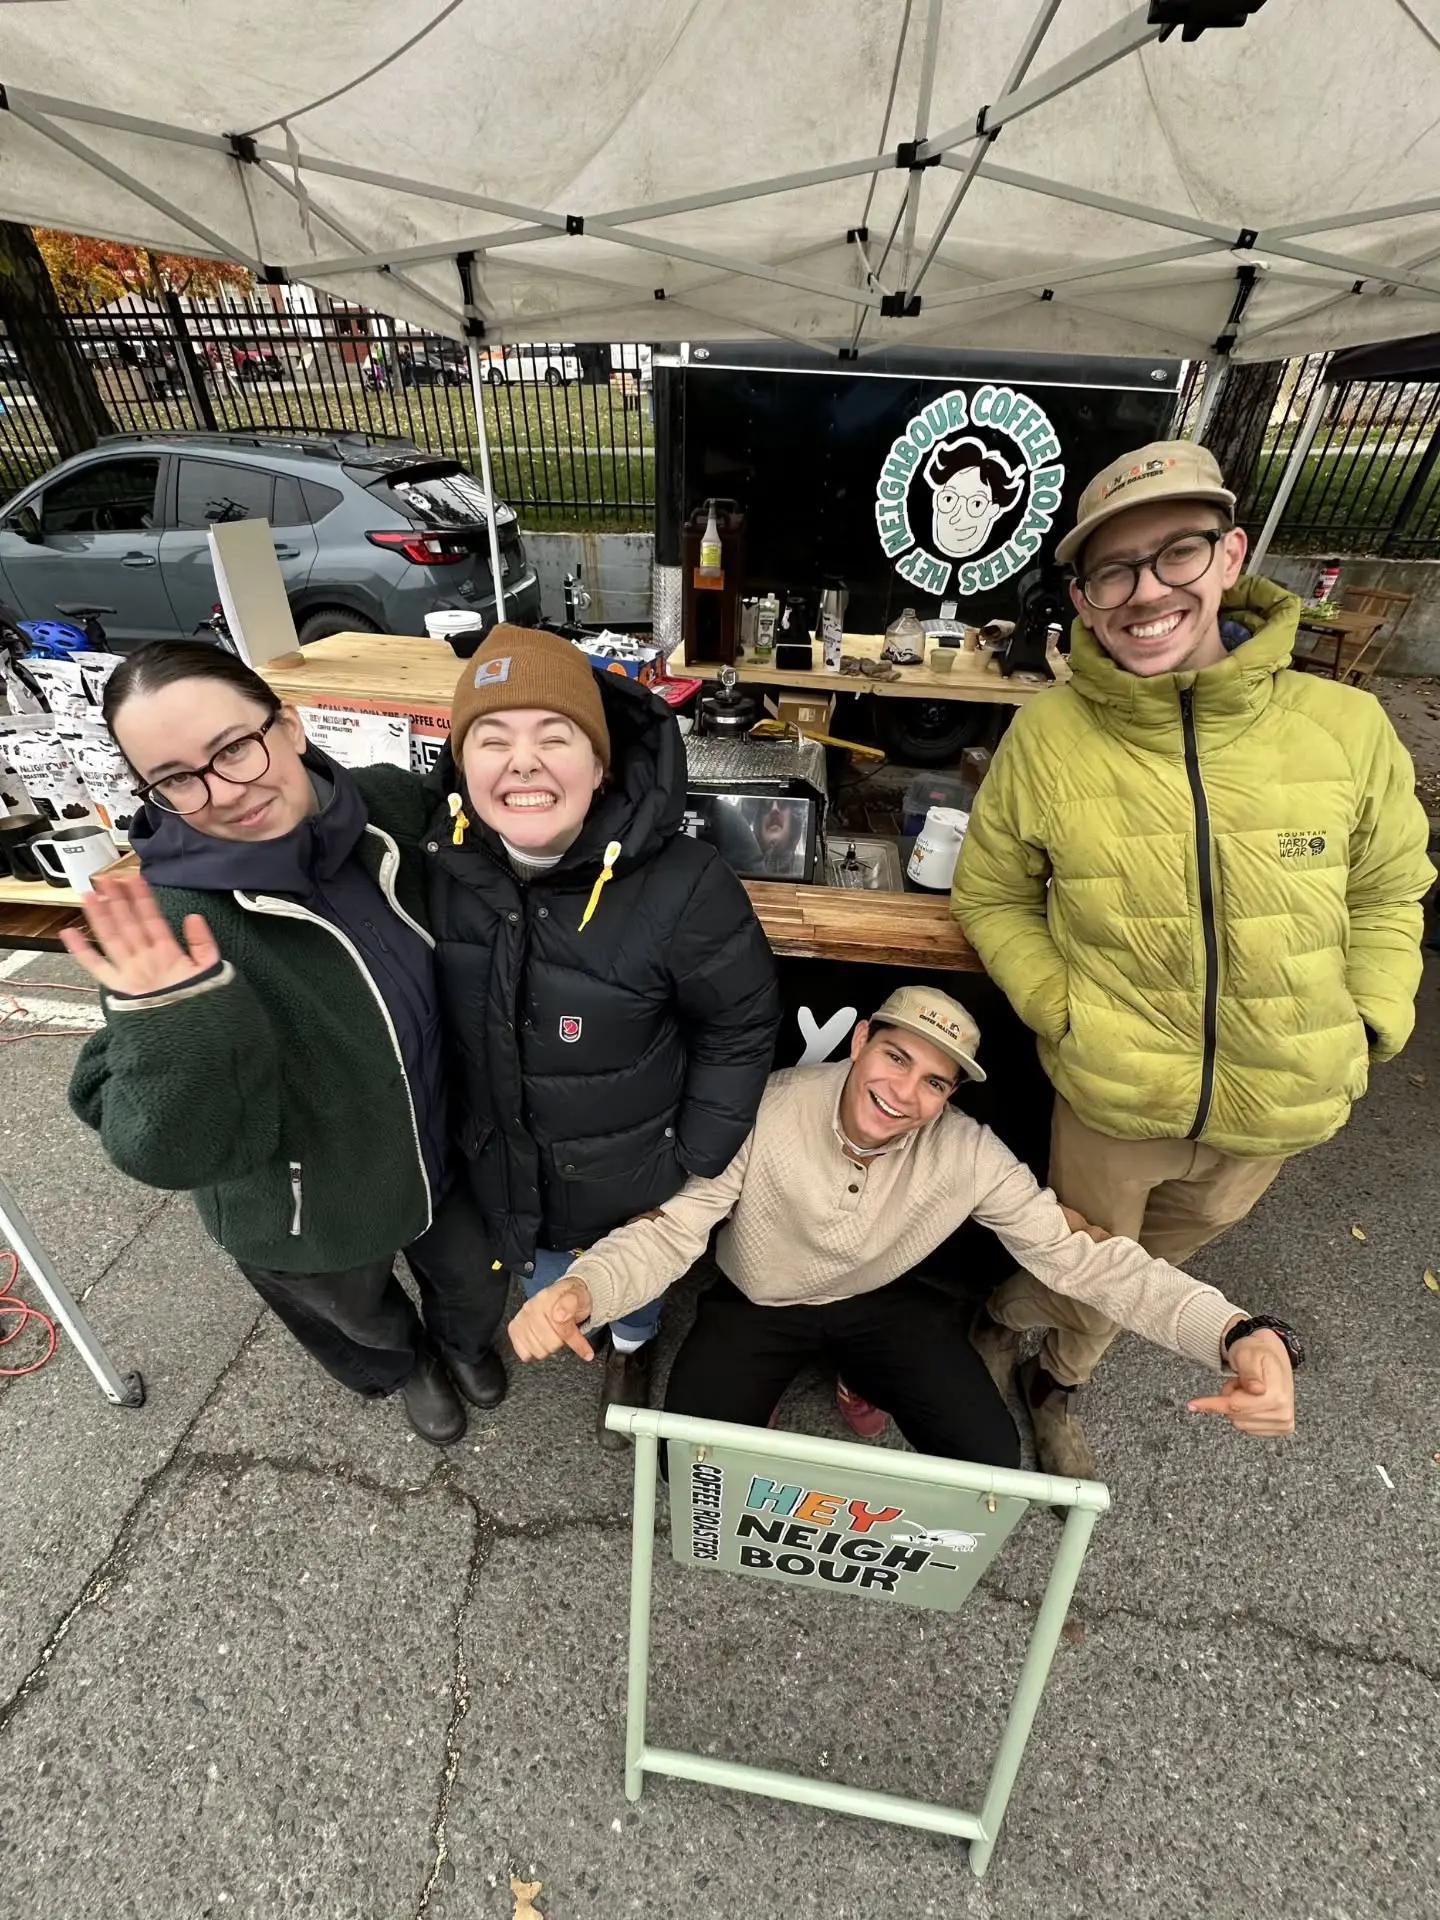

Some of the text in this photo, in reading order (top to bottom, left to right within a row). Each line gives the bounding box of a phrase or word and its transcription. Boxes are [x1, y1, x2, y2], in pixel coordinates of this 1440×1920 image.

[878, 388, 1063, 593] HEY NEIGHBOUR COFFEE ROASTERS
[1277, 830, 1327, 838] MOUNTAIN
[1279, 838, 1307, 849] HARD
[1279, 847, 1307, 858] WEAR
[691, 1463, 723, 1561] COFFEE ROASTERS
[745, 1476, 904, 1533] HEY
[735, 1514, 957, 1572] NEIGH-
[739, 1546, 899, 1593] BOUR
